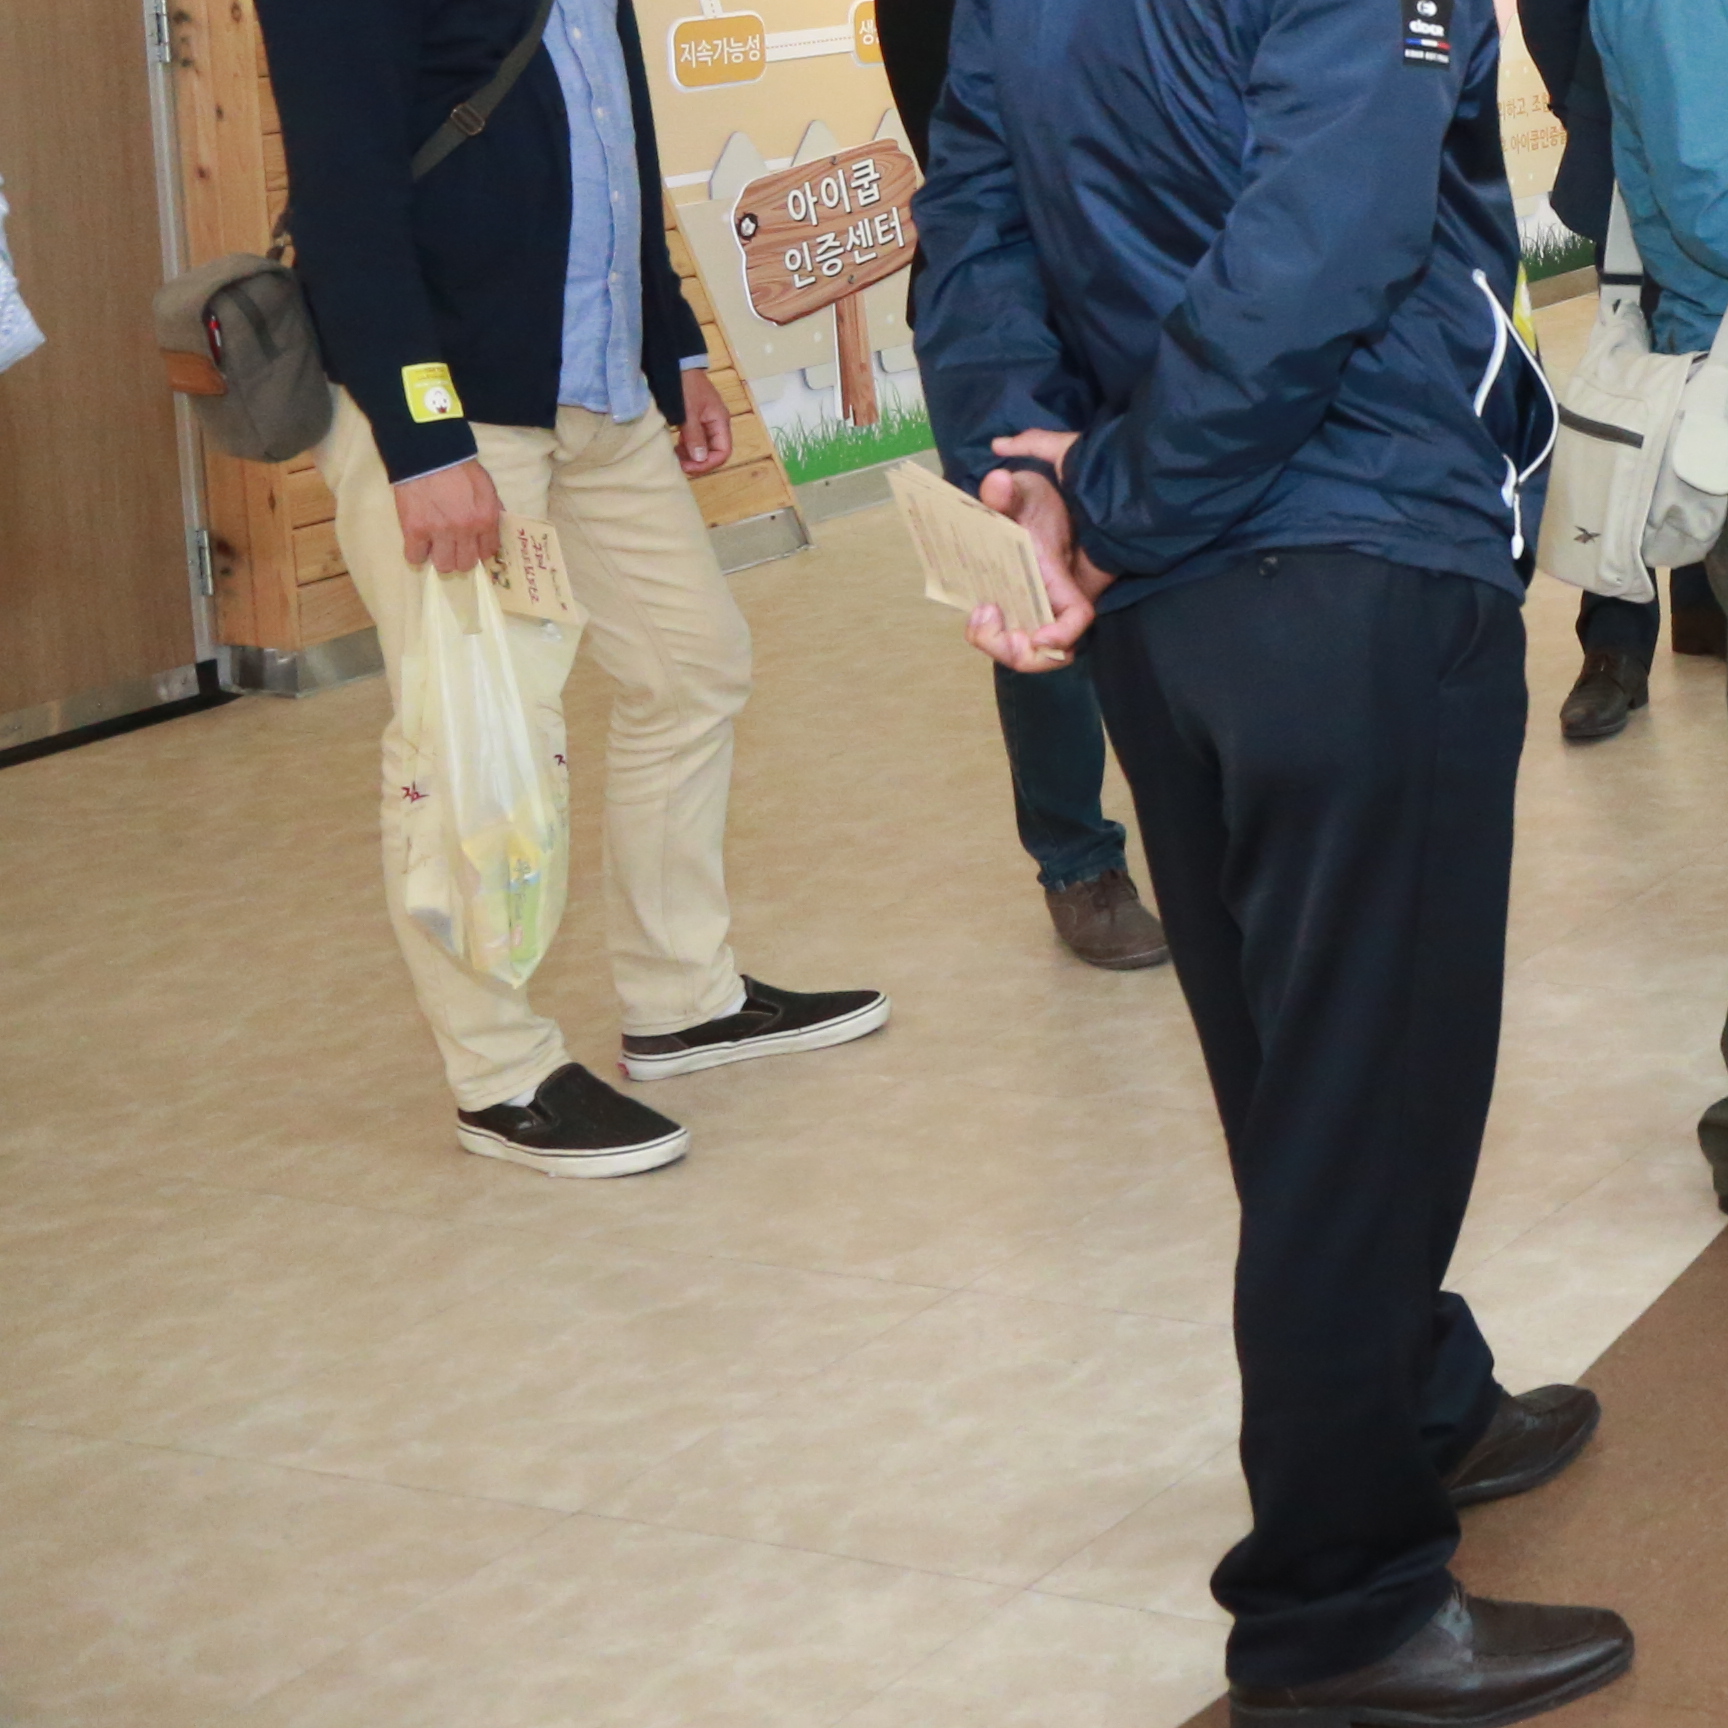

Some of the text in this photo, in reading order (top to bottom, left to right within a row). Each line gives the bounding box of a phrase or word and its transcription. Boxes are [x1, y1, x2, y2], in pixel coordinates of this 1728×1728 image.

[680, 33, 762, 69] 지속가능성
[787, 158, 881, 227] 아이쿱
[783, 207, 906, 290] 인증센터
